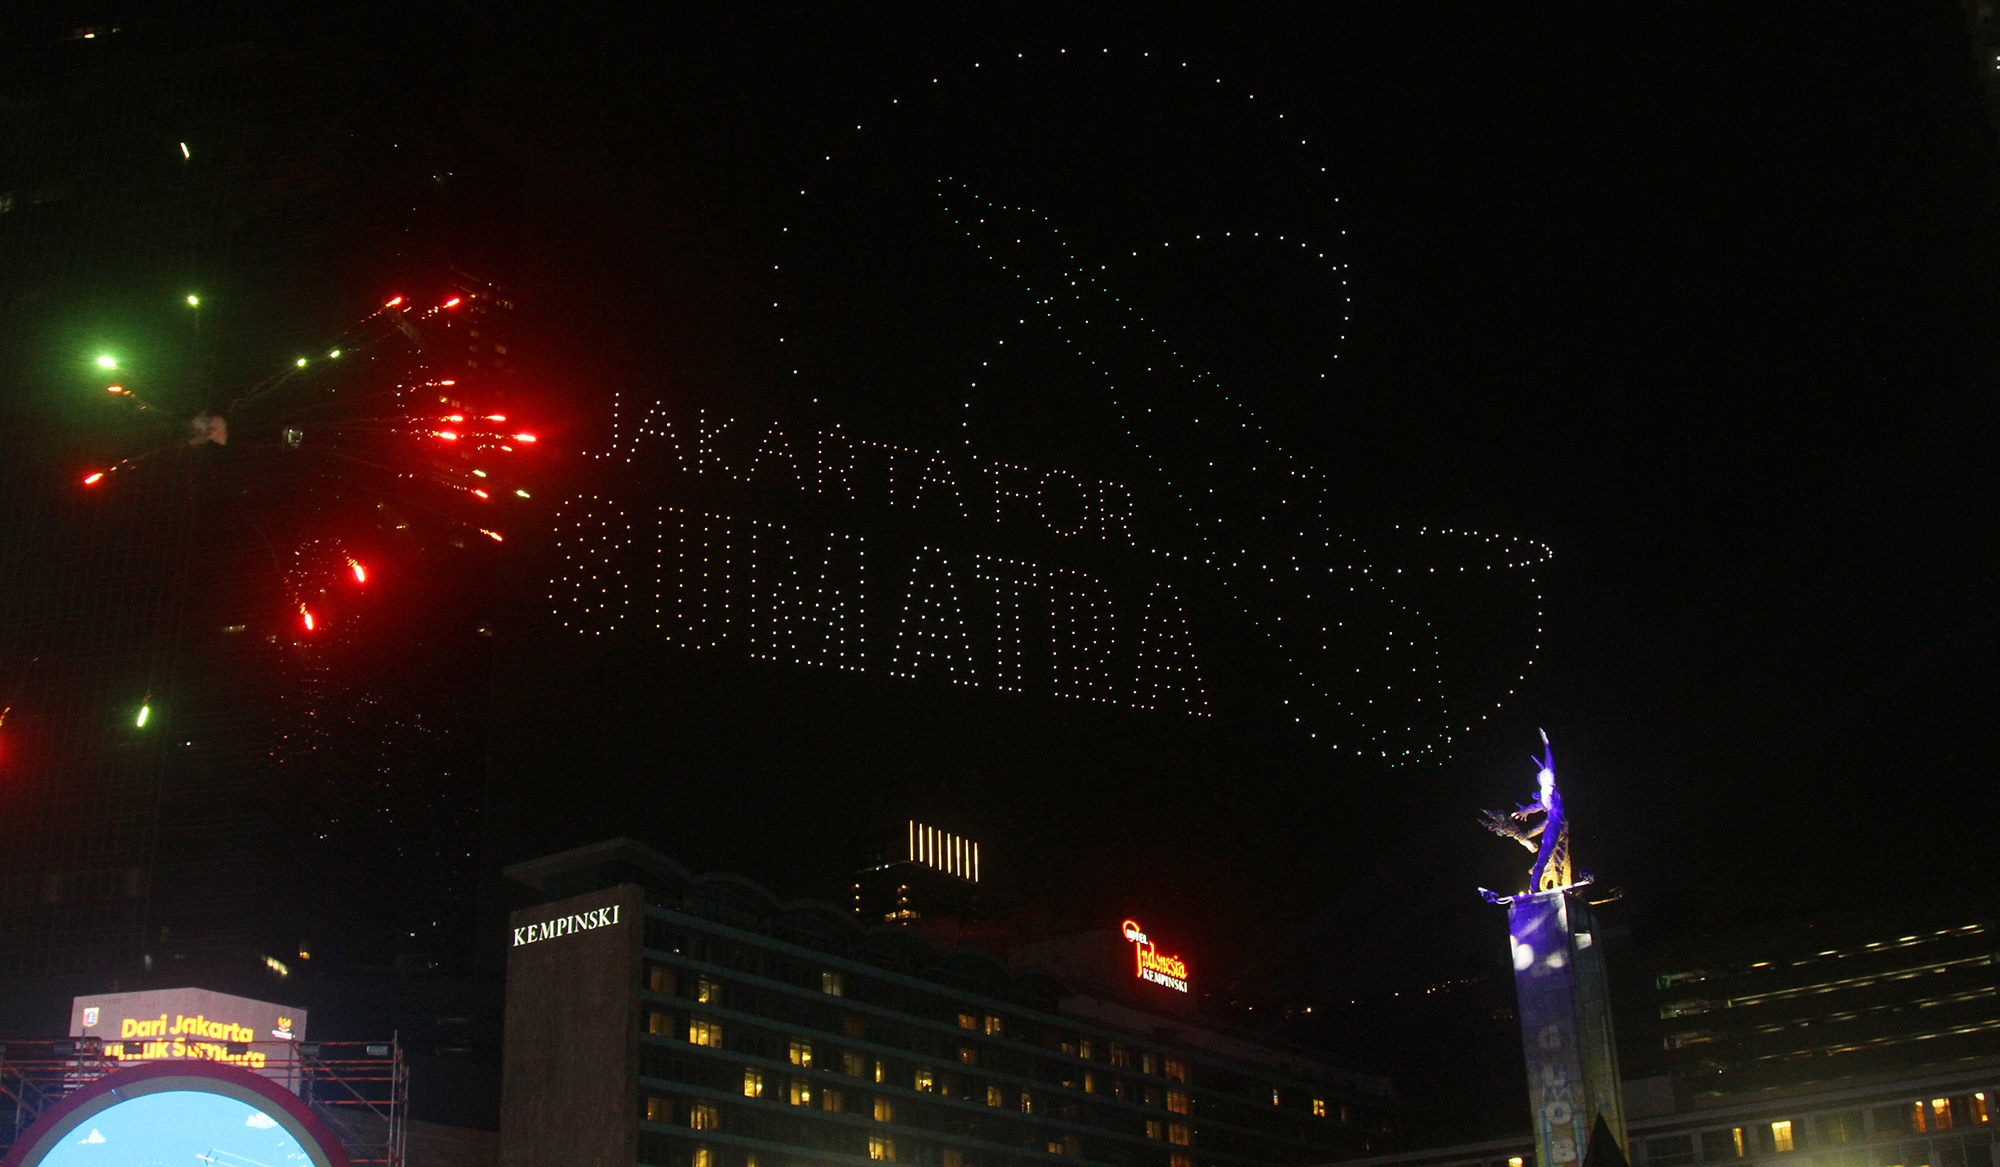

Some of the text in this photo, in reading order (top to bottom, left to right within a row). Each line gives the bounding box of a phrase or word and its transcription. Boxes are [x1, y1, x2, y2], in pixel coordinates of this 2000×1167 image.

[581, 392, 1135, 546] JAKARTA FOR
[548, 494, 1212, 718] SUMATRA
[513, 905, 620, 947] KEMPINSKI
[1143, 967, 1188, 993] KEMPINSKI
[121, 1014, 168, 1038] Dari
[169, 1015, 254, 1043] Jakarta
